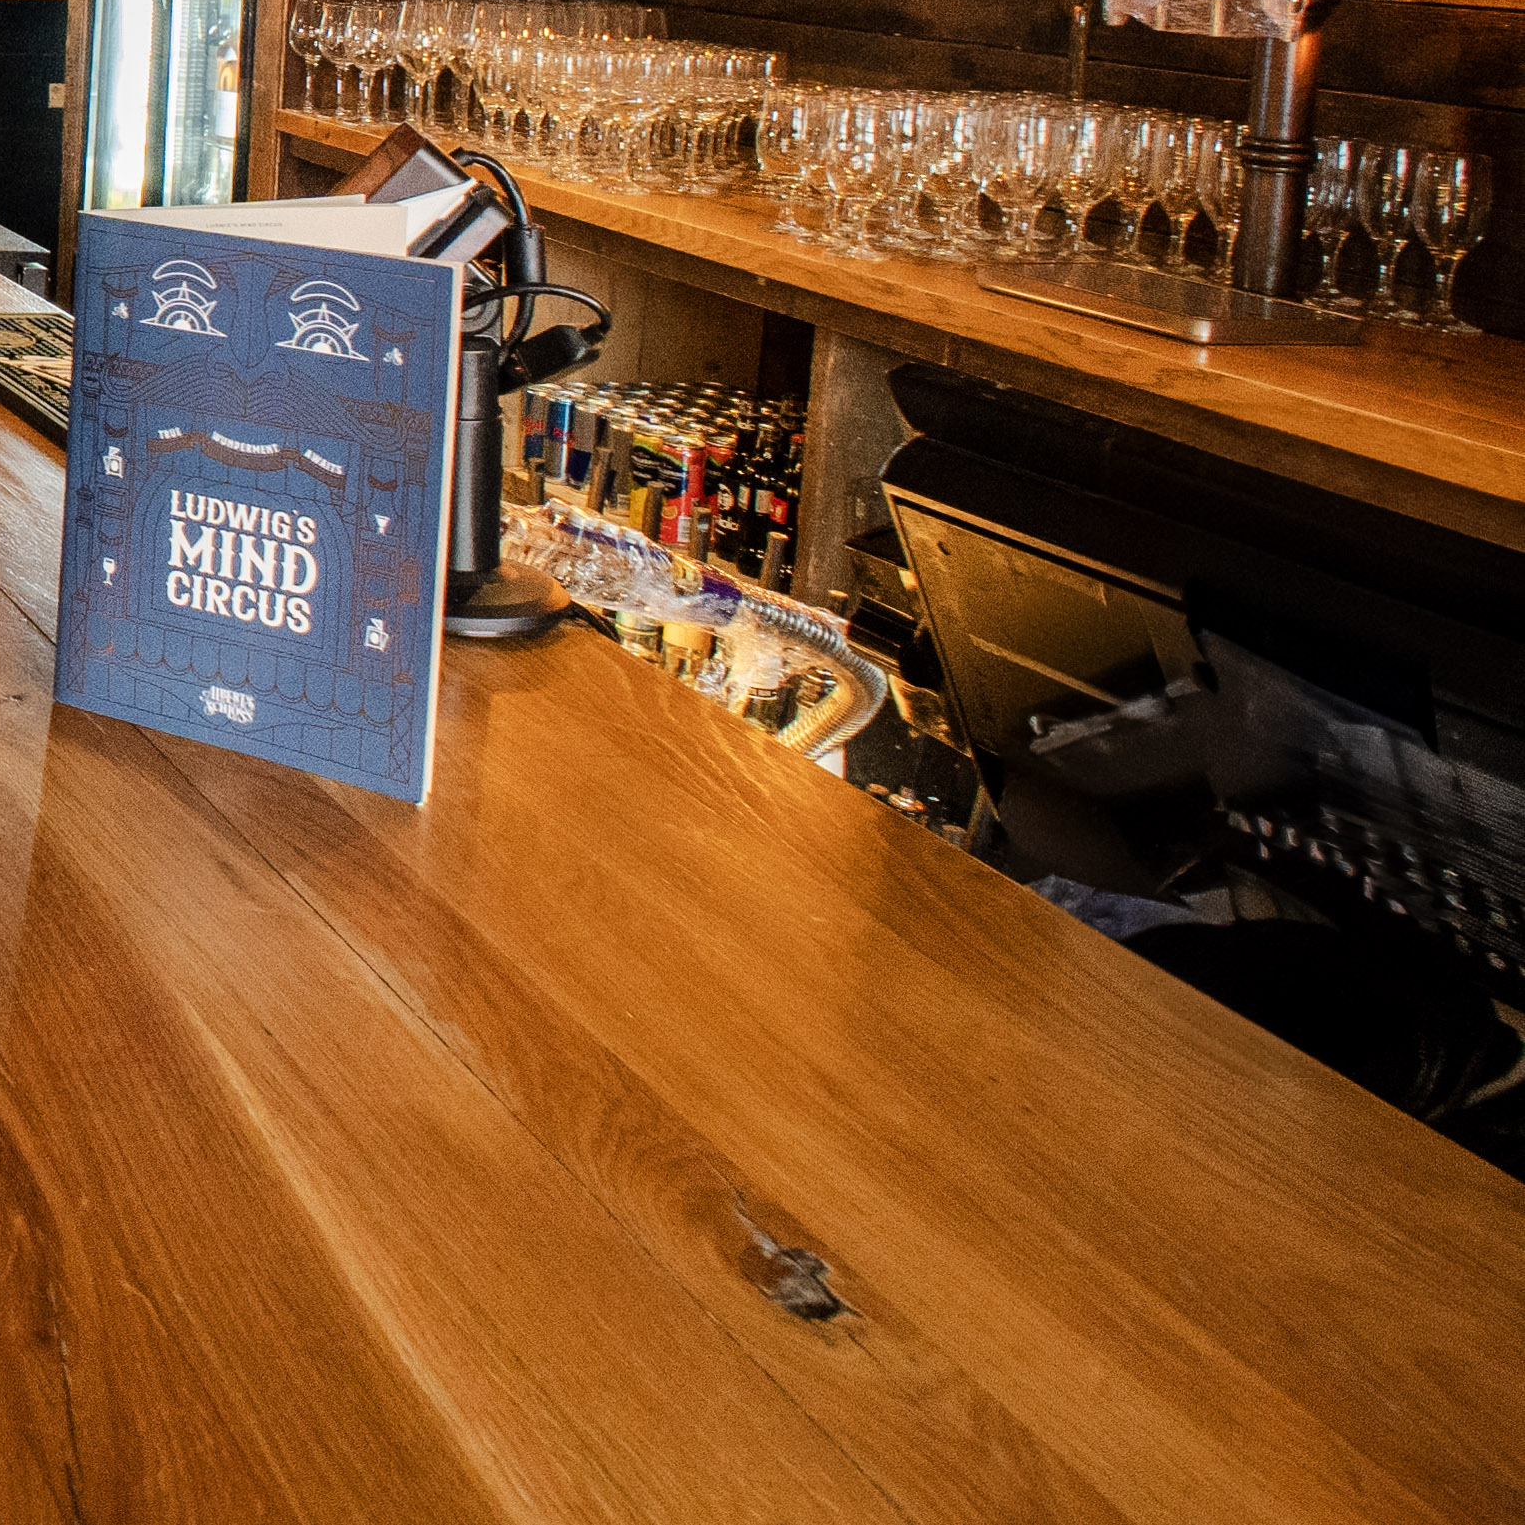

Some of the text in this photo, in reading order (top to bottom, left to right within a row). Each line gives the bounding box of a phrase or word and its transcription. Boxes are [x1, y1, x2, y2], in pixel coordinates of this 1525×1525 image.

[169, 488, 318, 545] LUDWIG'S
[168, 518, 319, 595] MIND
[166, 570, 313, 635] CIRCUS
